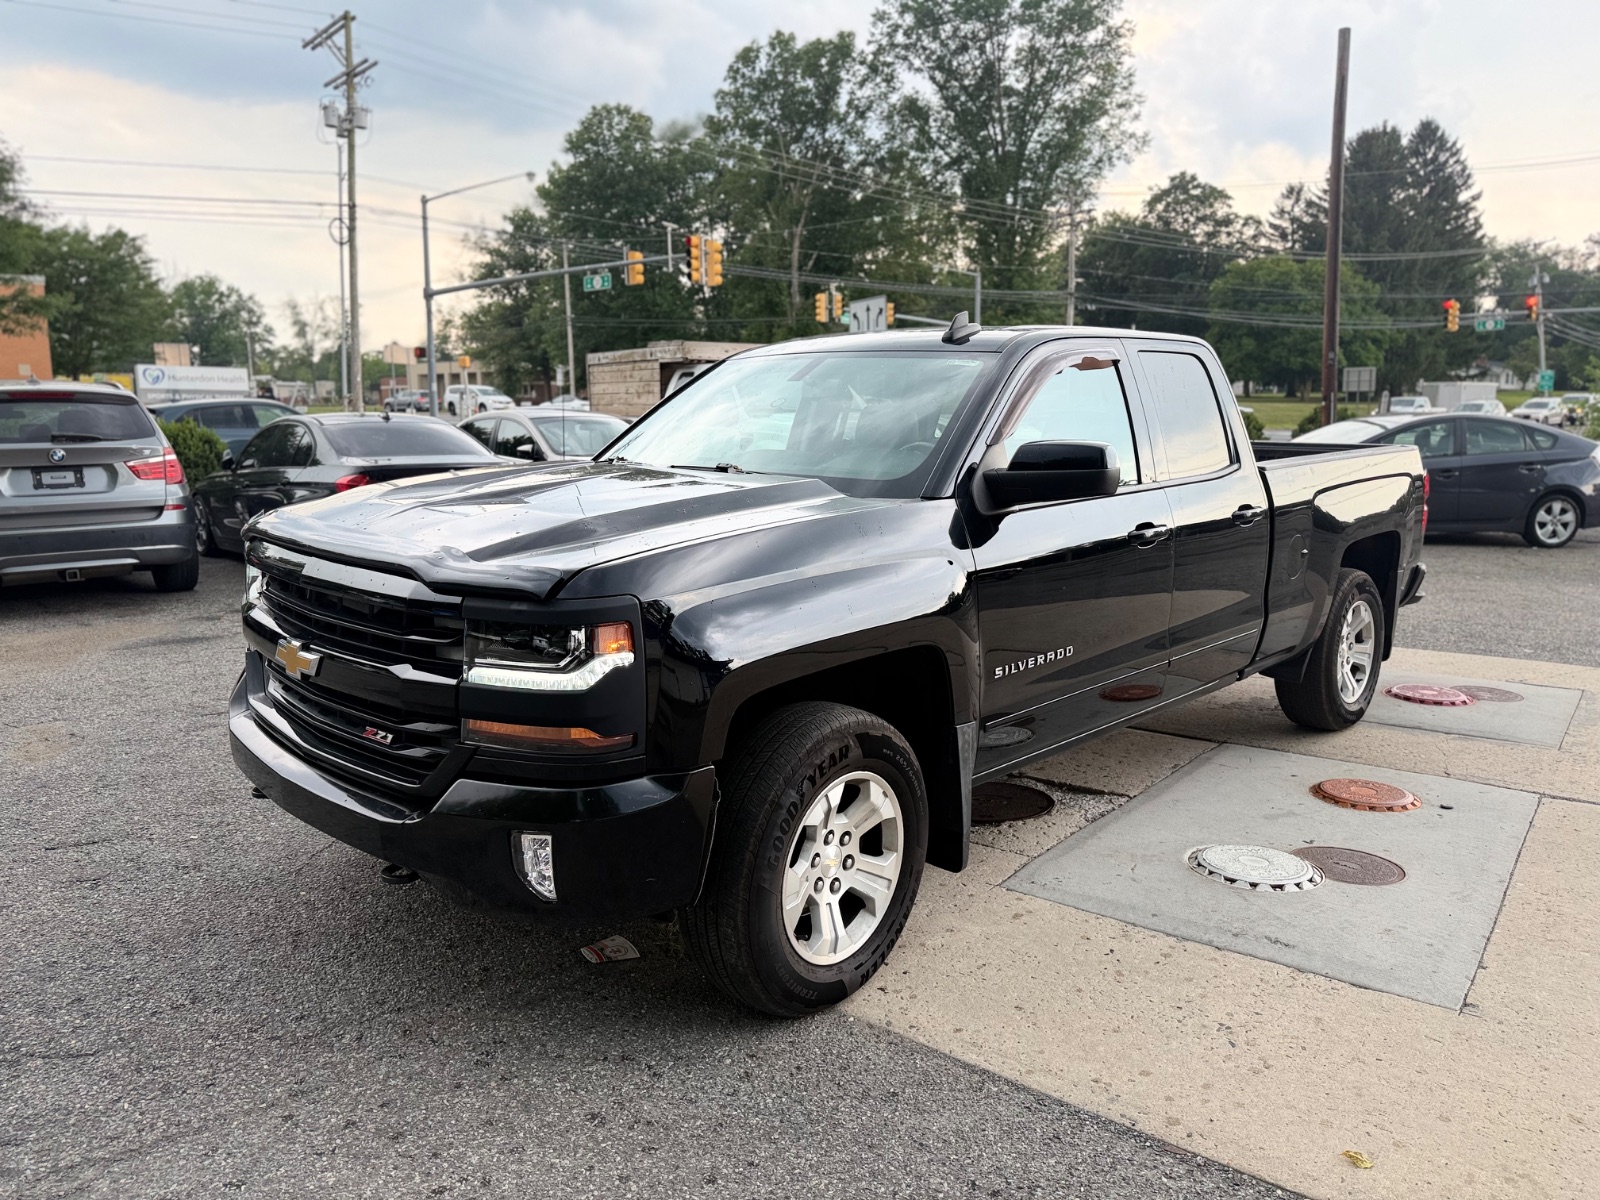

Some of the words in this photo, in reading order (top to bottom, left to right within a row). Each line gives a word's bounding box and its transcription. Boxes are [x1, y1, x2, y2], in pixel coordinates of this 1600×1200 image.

[168, 374, 215, 383] Hunterdon
[217, 375, 246, 384] Health
[994, 645, 1074, 679] SILVERADO
[362, 726, 393, 745] Z71
[767, 745, 849, 872] GOODYEAR
[774, 962, 818, 1000] TERRITORY
